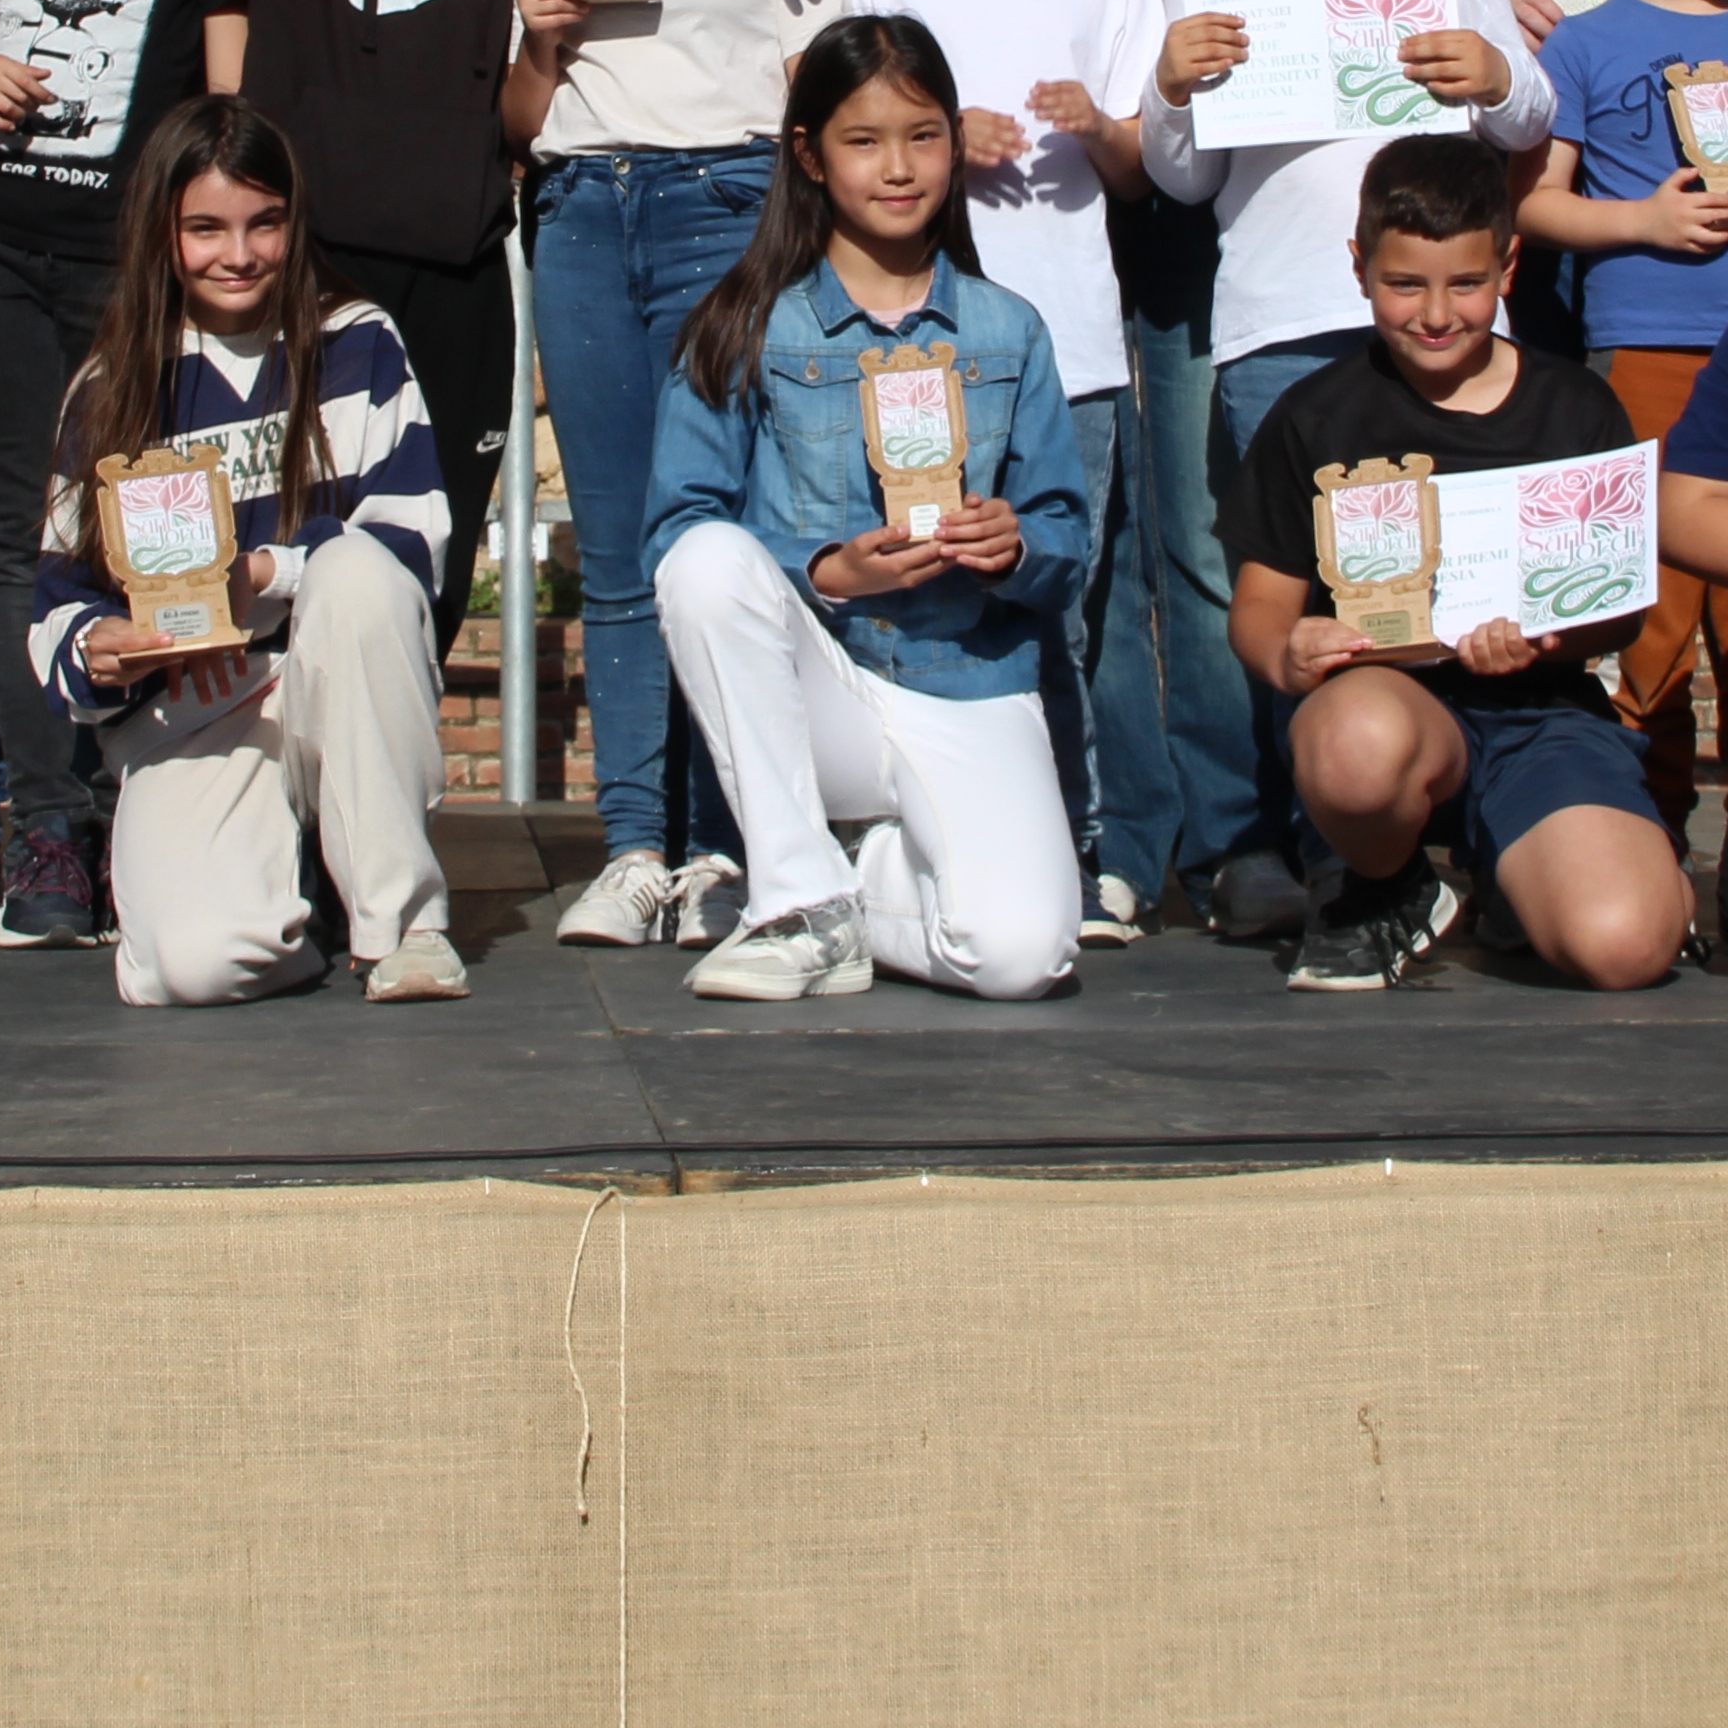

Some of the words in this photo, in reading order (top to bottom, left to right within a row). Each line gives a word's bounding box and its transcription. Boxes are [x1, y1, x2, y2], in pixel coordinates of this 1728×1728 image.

[1270, 52, 1320, 67] BREUS
[1233, 68, 1322, 87] DIVERSITAT
[1524, 529, 1586, 553] Sant
[1567, 525, 1637, 567] Jordi
[1457, 548, 1510, 569] PREMI
[1439, 569, 1476, 584] ESIA
